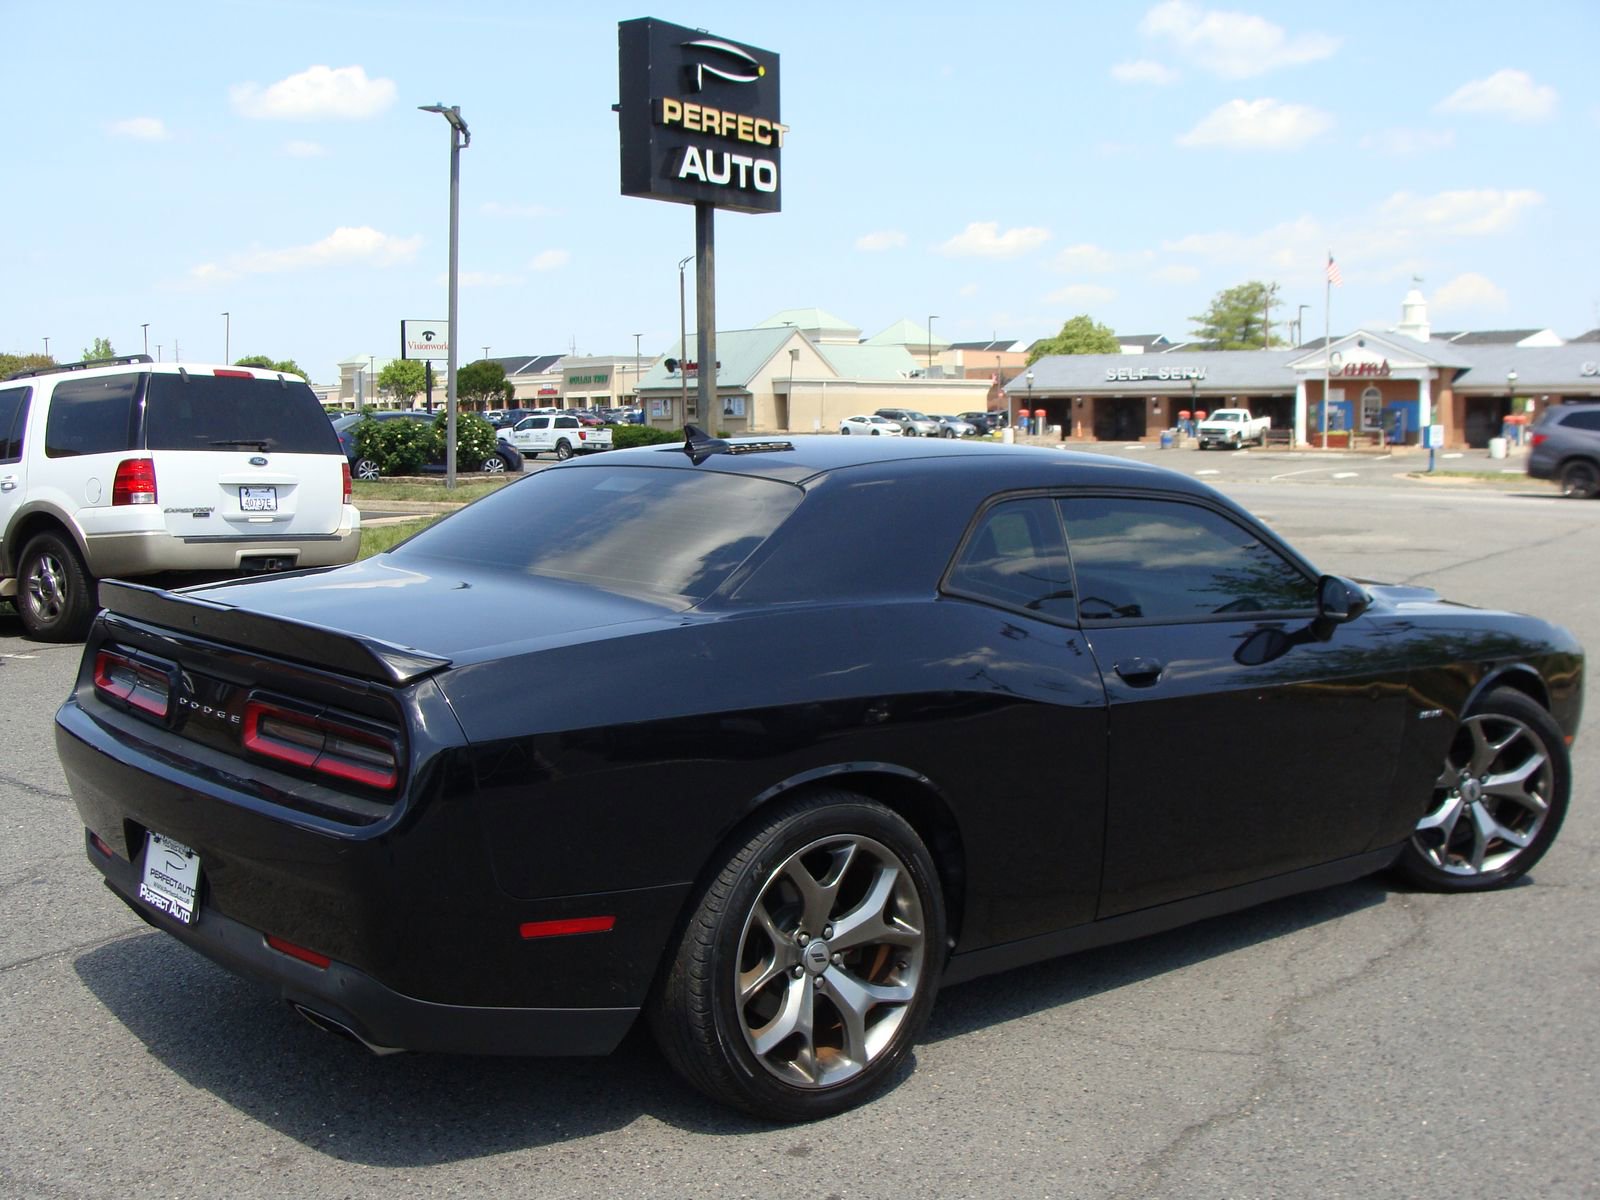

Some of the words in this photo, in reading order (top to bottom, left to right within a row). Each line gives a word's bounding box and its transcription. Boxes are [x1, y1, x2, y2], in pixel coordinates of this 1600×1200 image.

[663, 97, 790, 149] PERFECT
[678, 145, 778, 193] AUTO
[407, 341, 449, 350] Visionwork
[1106, 367, 1150, 380] SELF
[179, 697, 241, 723] DODGE
[140, 883, 170, 911] PERFECT
[168, 899, 191, 924] AUTO
